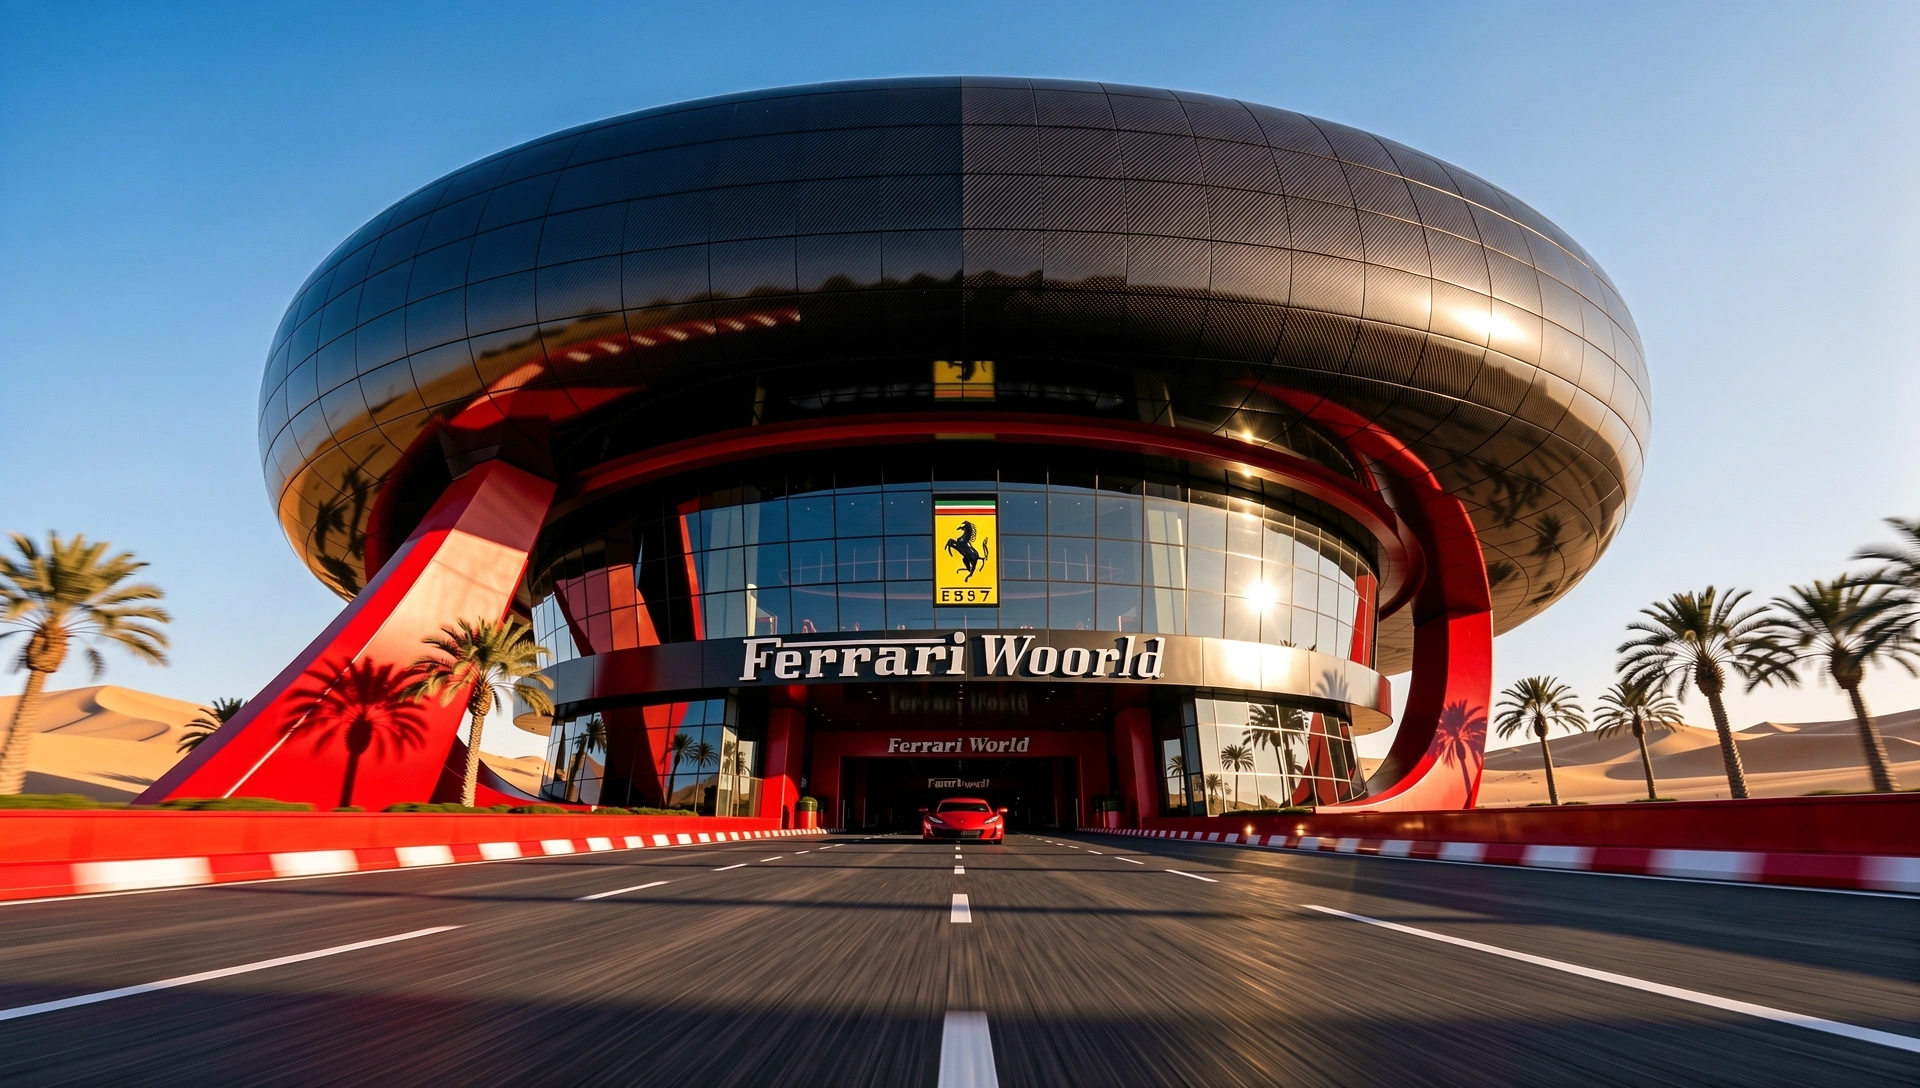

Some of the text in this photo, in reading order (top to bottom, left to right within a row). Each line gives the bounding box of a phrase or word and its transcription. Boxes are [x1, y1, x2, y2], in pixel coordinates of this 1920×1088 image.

[739, 631, 1165, 681] Ferrari Woorld
[888, 737, 1030, 753] Ferrari World
